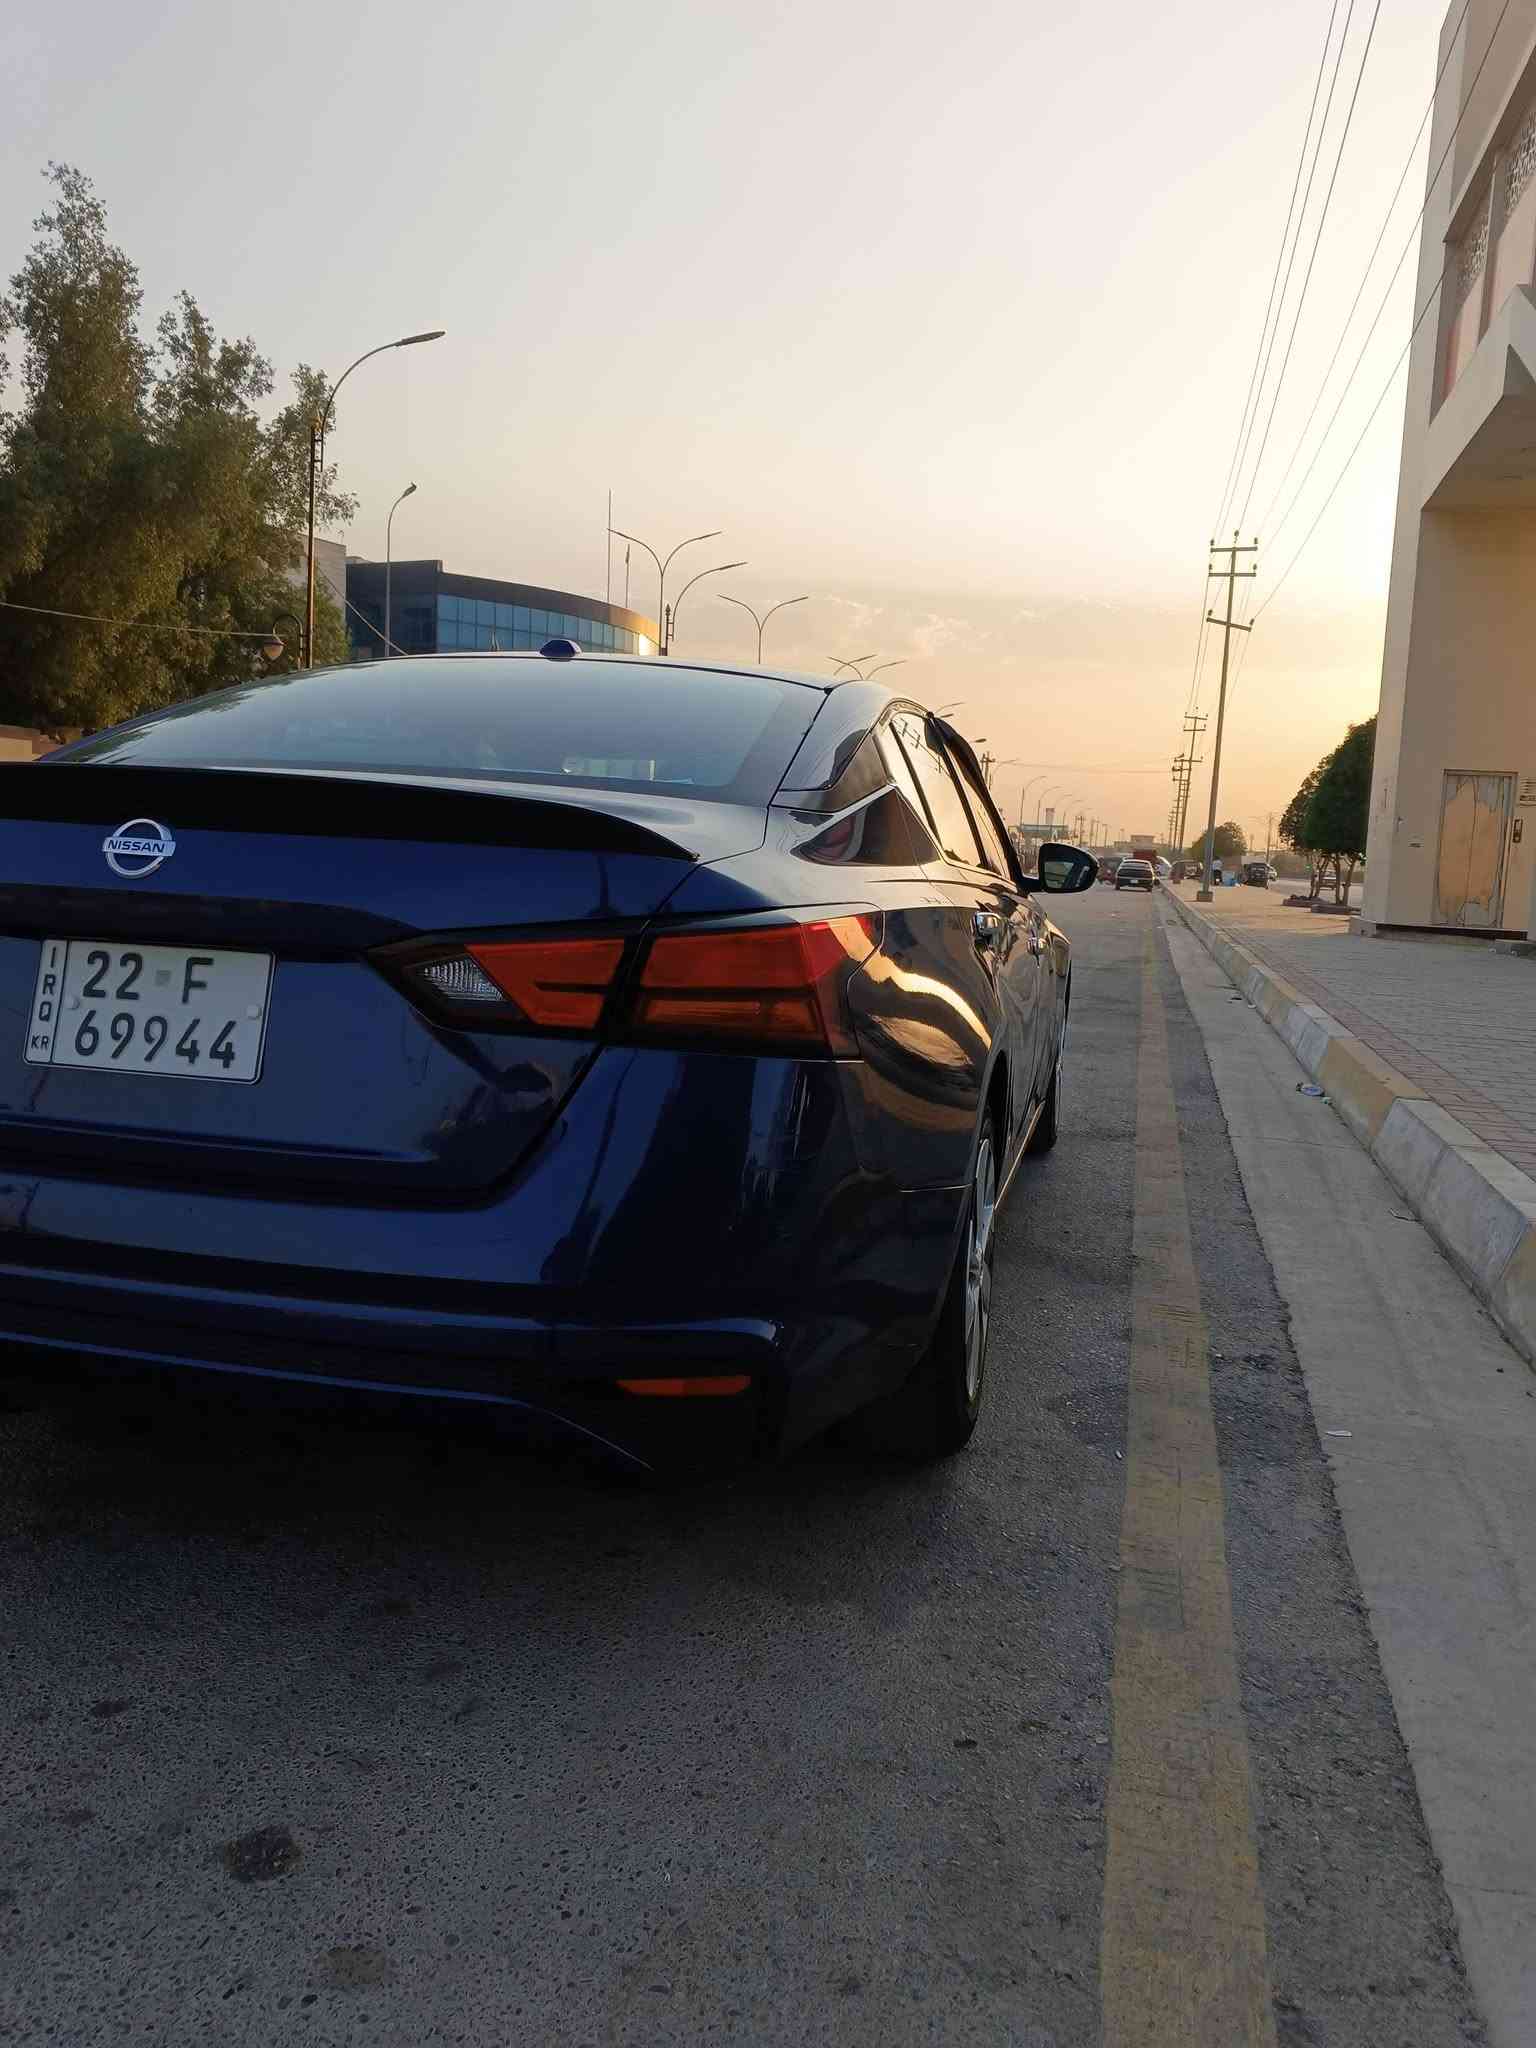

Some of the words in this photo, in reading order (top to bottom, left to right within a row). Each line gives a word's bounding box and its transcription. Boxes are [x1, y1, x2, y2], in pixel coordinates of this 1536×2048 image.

[107, 839, 165, 853] NISSAN
[83, 951, 143, 1000] 22
[181, 957, 214, 1003] F
[30, 1035, 50, 1050] KR
[75, 1010, 236, 1068] 69944
